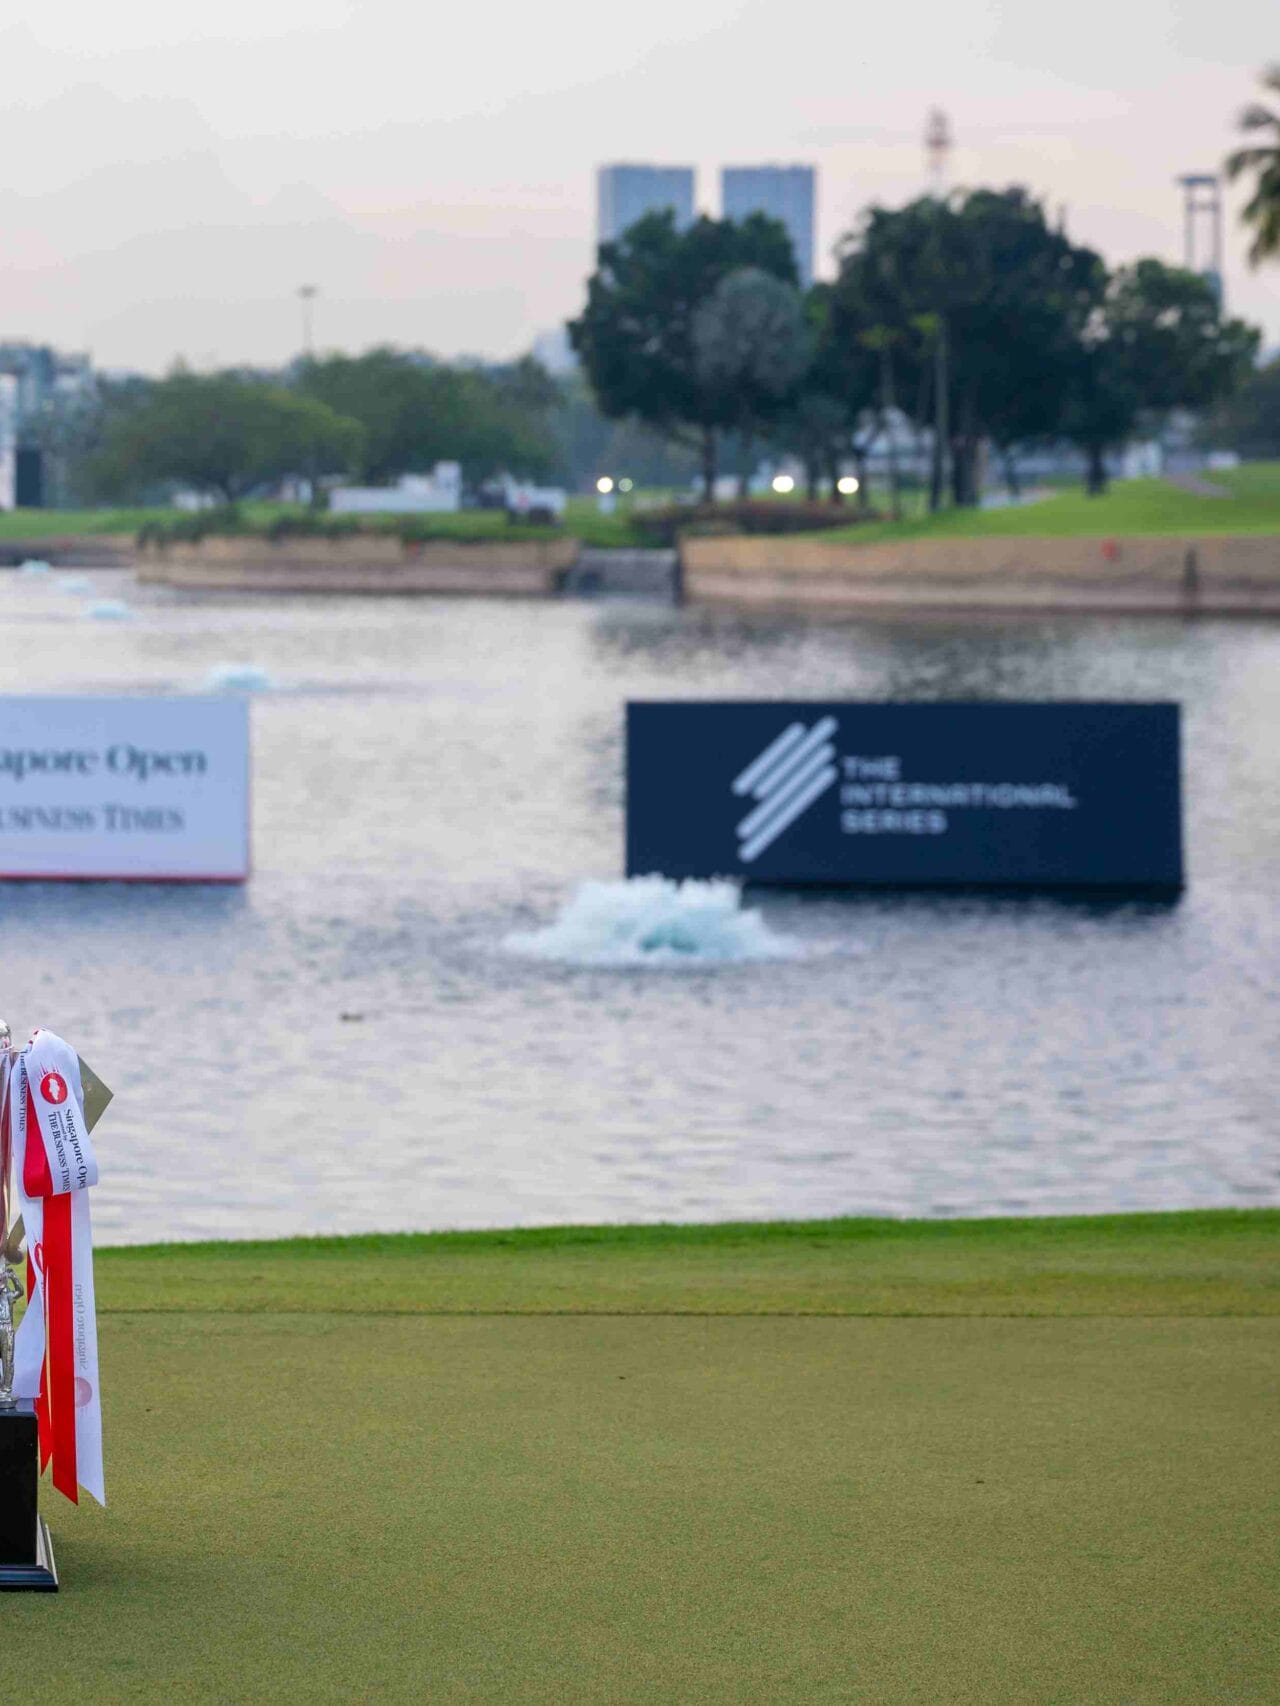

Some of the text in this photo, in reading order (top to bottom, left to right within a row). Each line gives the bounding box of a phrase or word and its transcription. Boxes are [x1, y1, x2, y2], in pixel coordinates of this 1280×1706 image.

[106, 743, 208, 783] Open
[843, 756, 901, 781] THE
[841, 783, 1078, 809] INTERNATIONAL
[102, 801, 187, 831] TIMES
[841, 809, 949, 835] SERIES
[19, 1067, 27, 1105] BUSINESS
[19, 1107, 27, 1132] TIMES
[47, 1112, 60, 1131] THE
[51, 1130, 68, 1168] BUSINESS
[63, 1109, 85, 1164] Singapore
